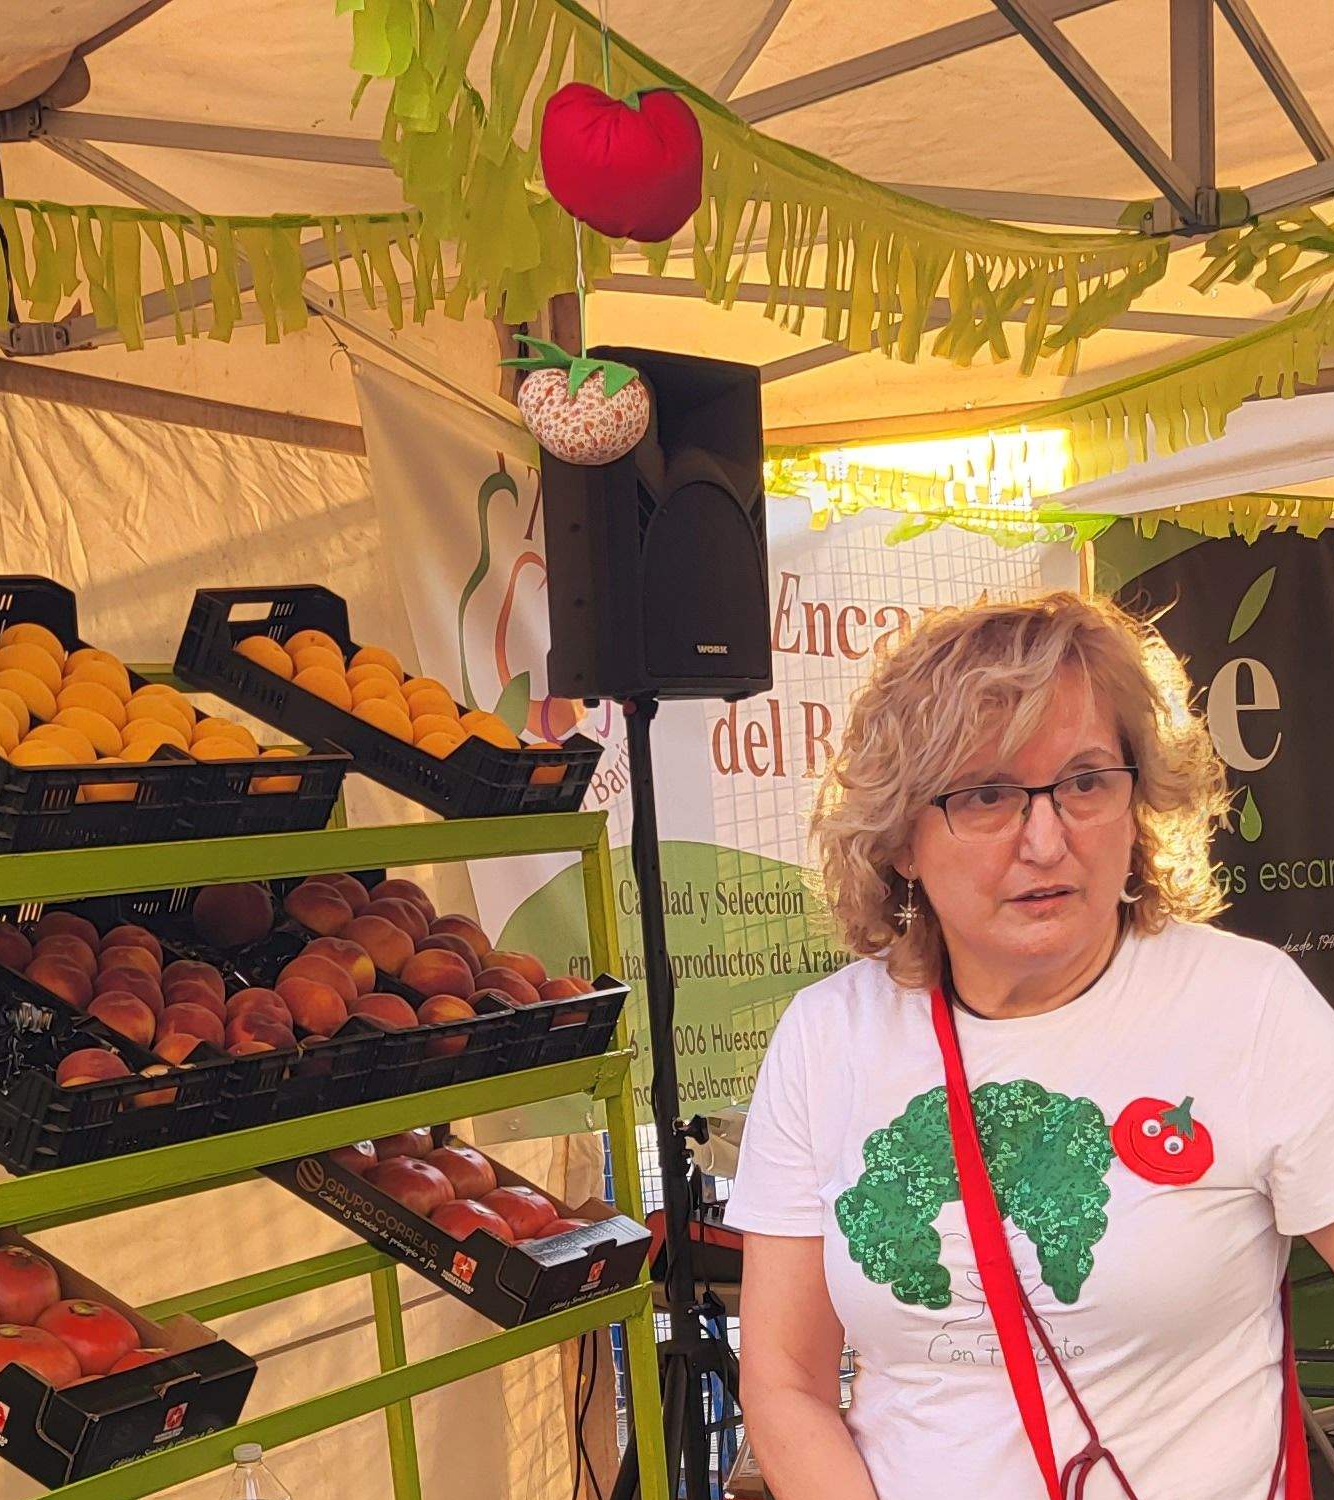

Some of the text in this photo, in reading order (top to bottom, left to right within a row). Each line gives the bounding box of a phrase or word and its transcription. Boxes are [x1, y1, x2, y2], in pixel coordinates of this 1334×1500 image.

[696, 644, 728, 655] WORK
[712, 699, 786, 778] del
[700, 892, 710, 925] y
[717, 880, 805, 917] Selección
[674, 944, 765, 989] productos
[770, 943, 792, 975] de
[797, 941, 859, 973] Arag
[673, 1024, 707, 1057] 006
[711, 1024, 768, 1052] Huesca
[325, 1177, 440, 1258] GRUPO CORREAS
